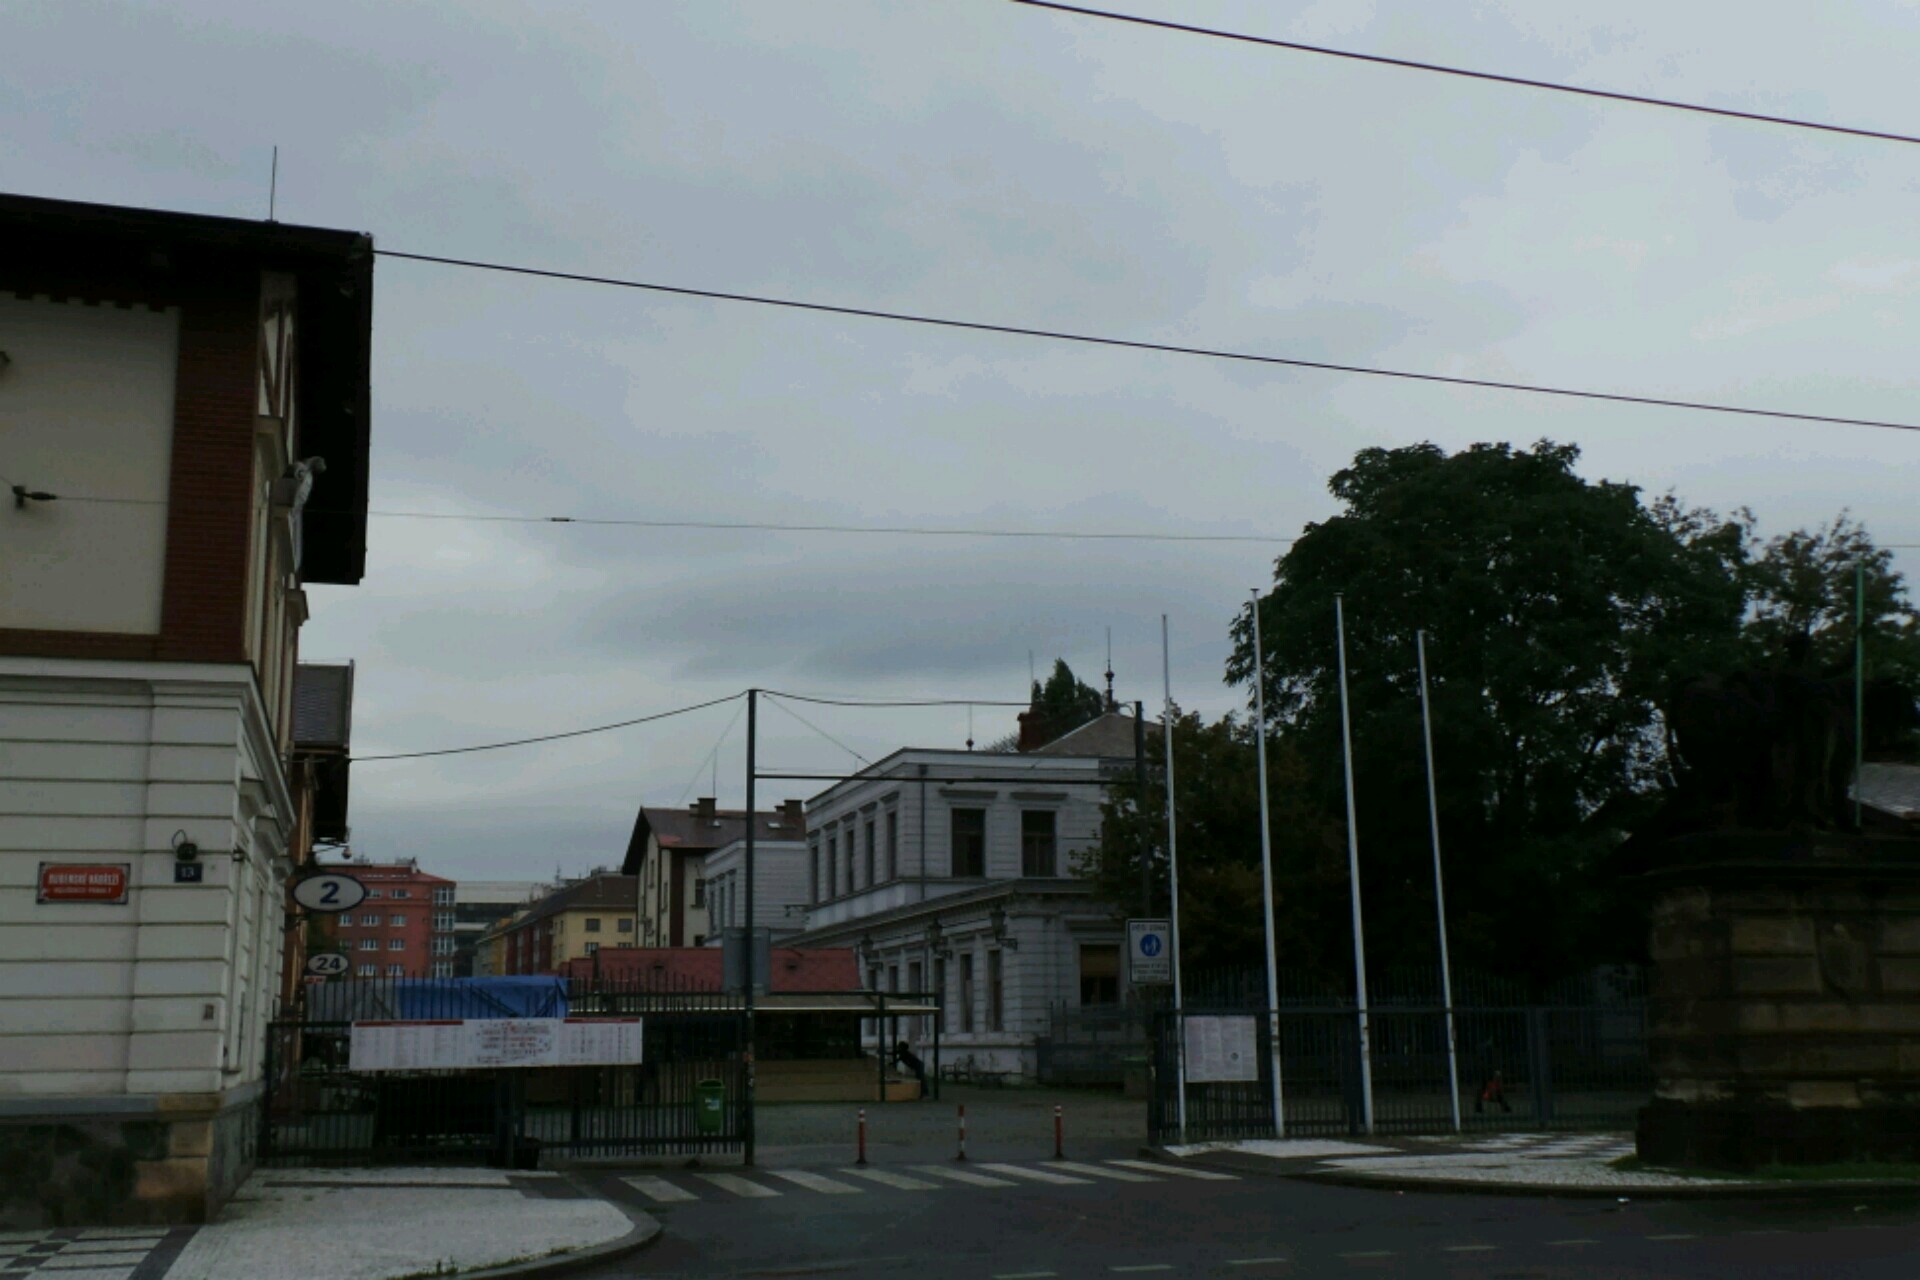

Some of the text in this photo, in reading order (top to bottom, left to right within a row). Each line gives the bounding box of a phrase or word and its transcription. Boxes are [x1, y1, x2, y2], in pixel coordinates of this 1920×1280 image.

[181, 866, 195, 878] 13
[319, 881, 340, 904] 2
[317, 957, 341, 970] 24
